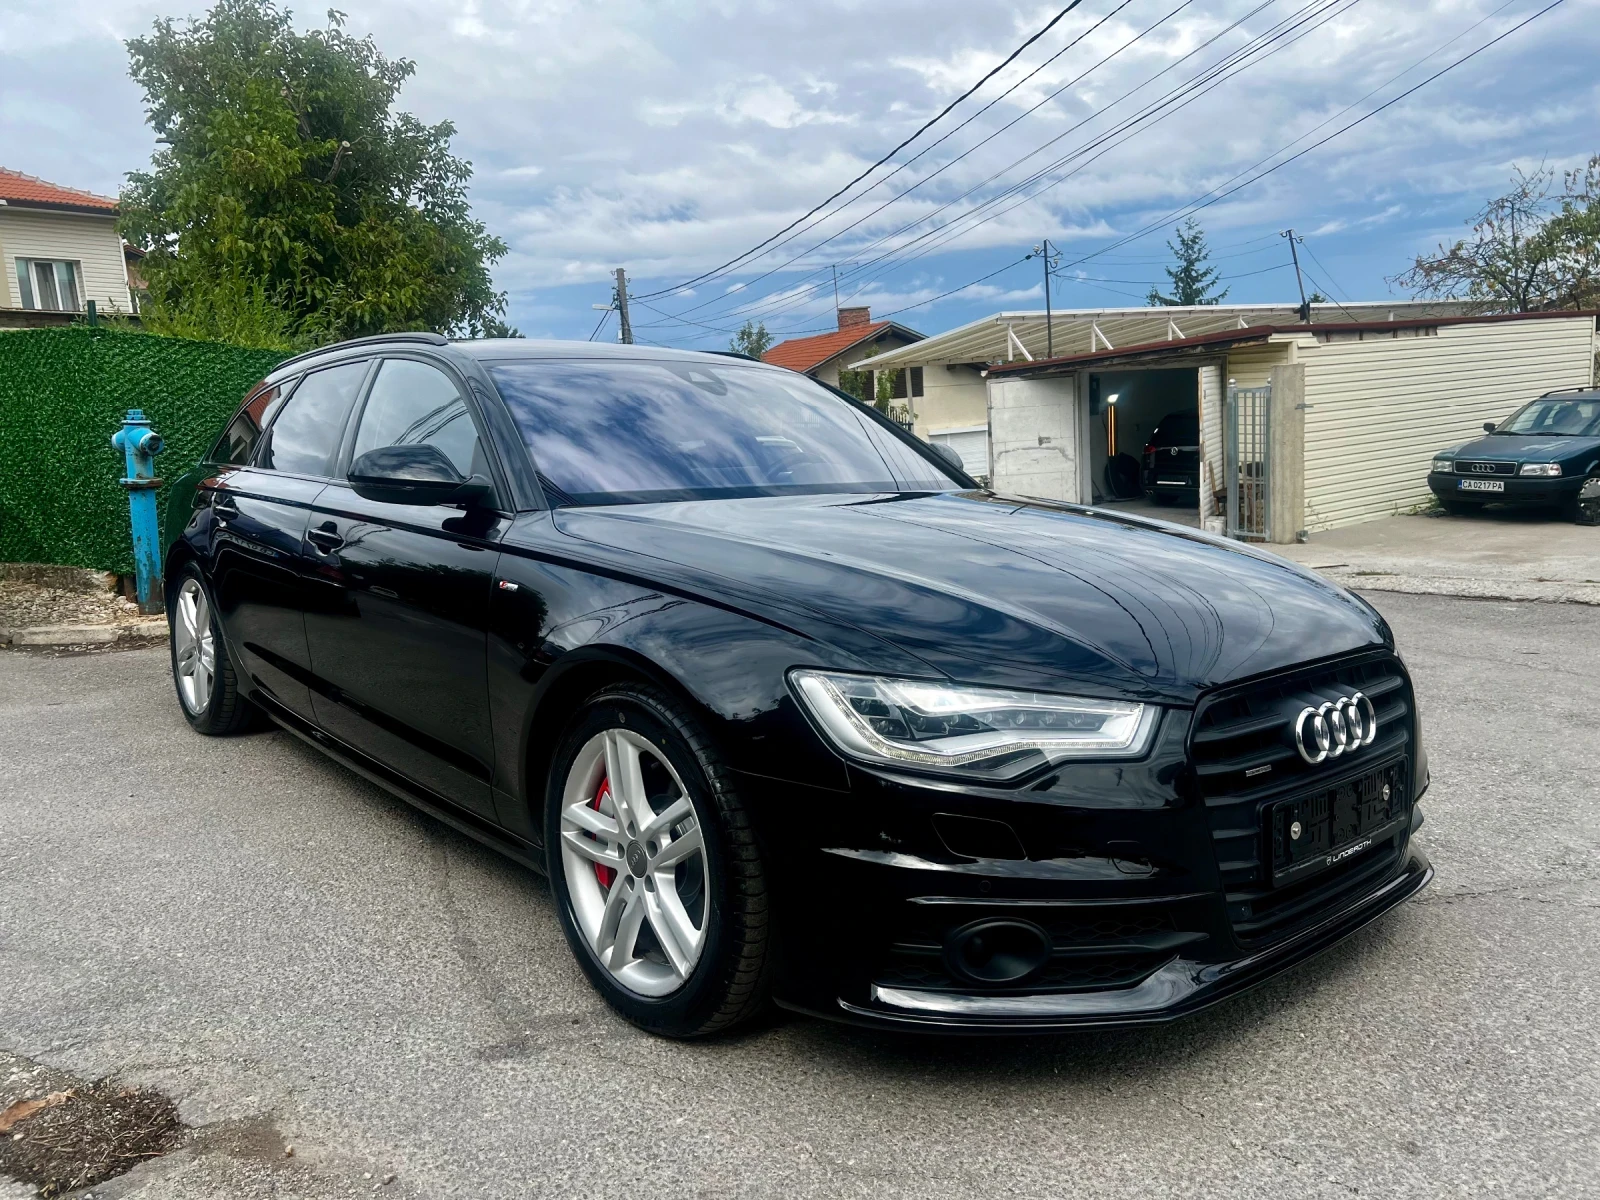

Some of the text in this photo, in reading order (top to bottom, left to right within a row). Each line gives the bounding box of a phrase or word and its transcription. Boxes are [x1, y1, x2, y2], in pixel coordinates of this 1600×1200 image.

[1462, 480, 1503, 490] CA 0217 PA
